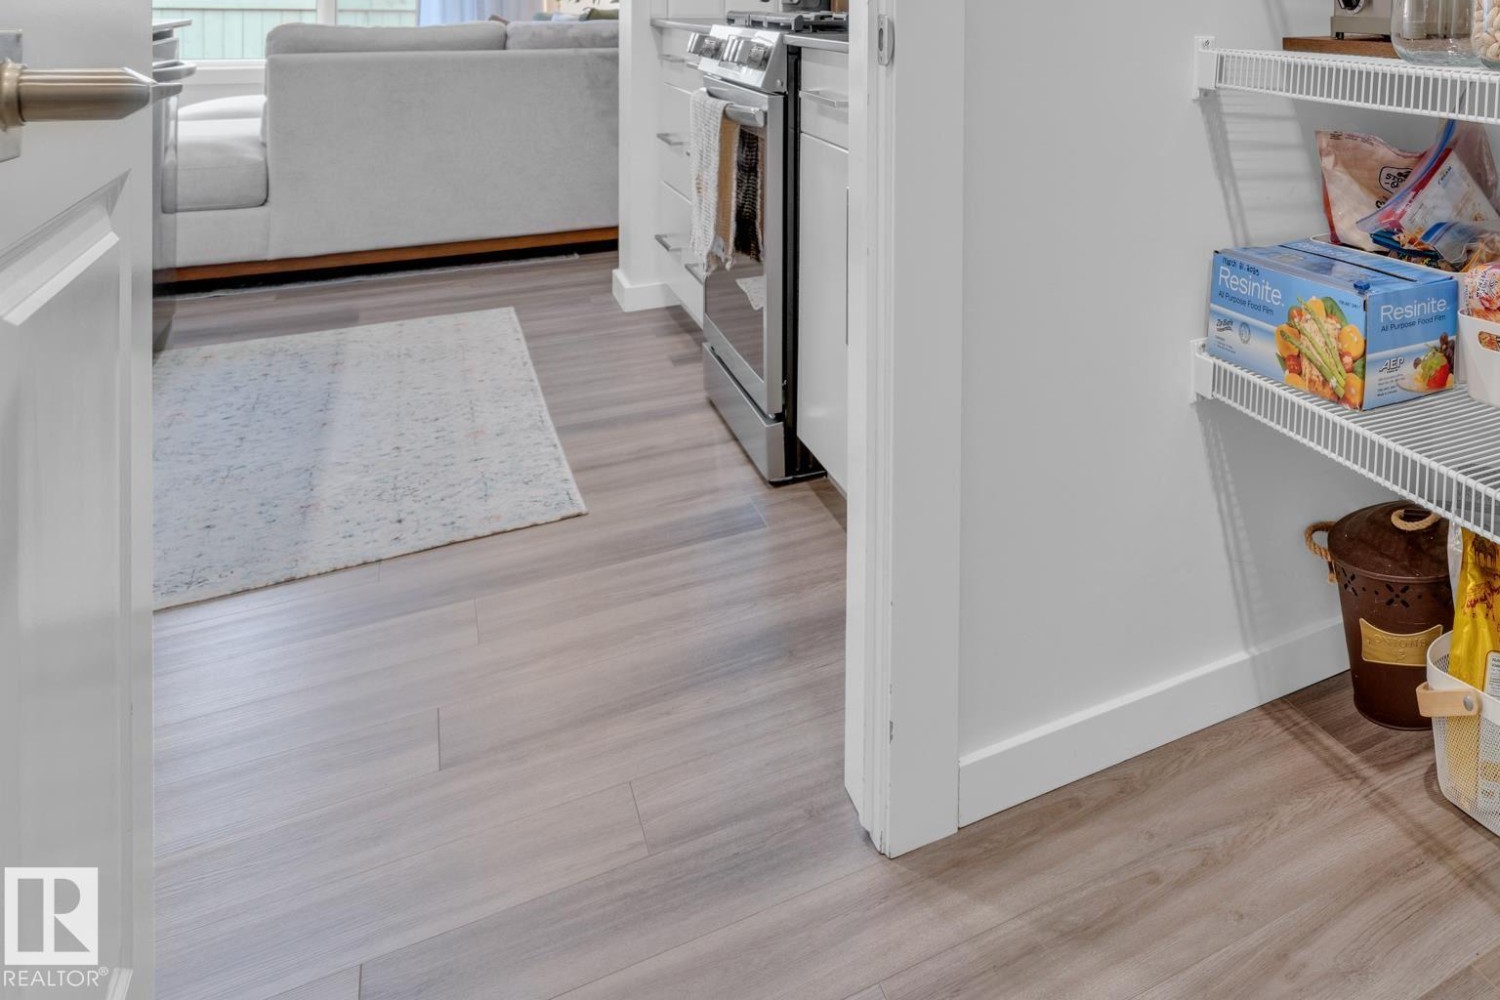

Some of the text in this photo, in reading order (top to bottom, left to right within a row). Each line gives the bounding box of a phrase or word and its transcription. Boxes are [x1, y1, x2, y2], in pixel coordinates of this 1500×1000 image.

[1218, 265, 1282, 306] Resinite
[1224, 292, 1247, 307] Purpose
[1247, 300, 1262, 312] Food
[1262, 305, 1274, 316] Film
[1380, 297, 1447, 323] Resinite
[1380, 314, 1446, 333] All Purpose Food Film
